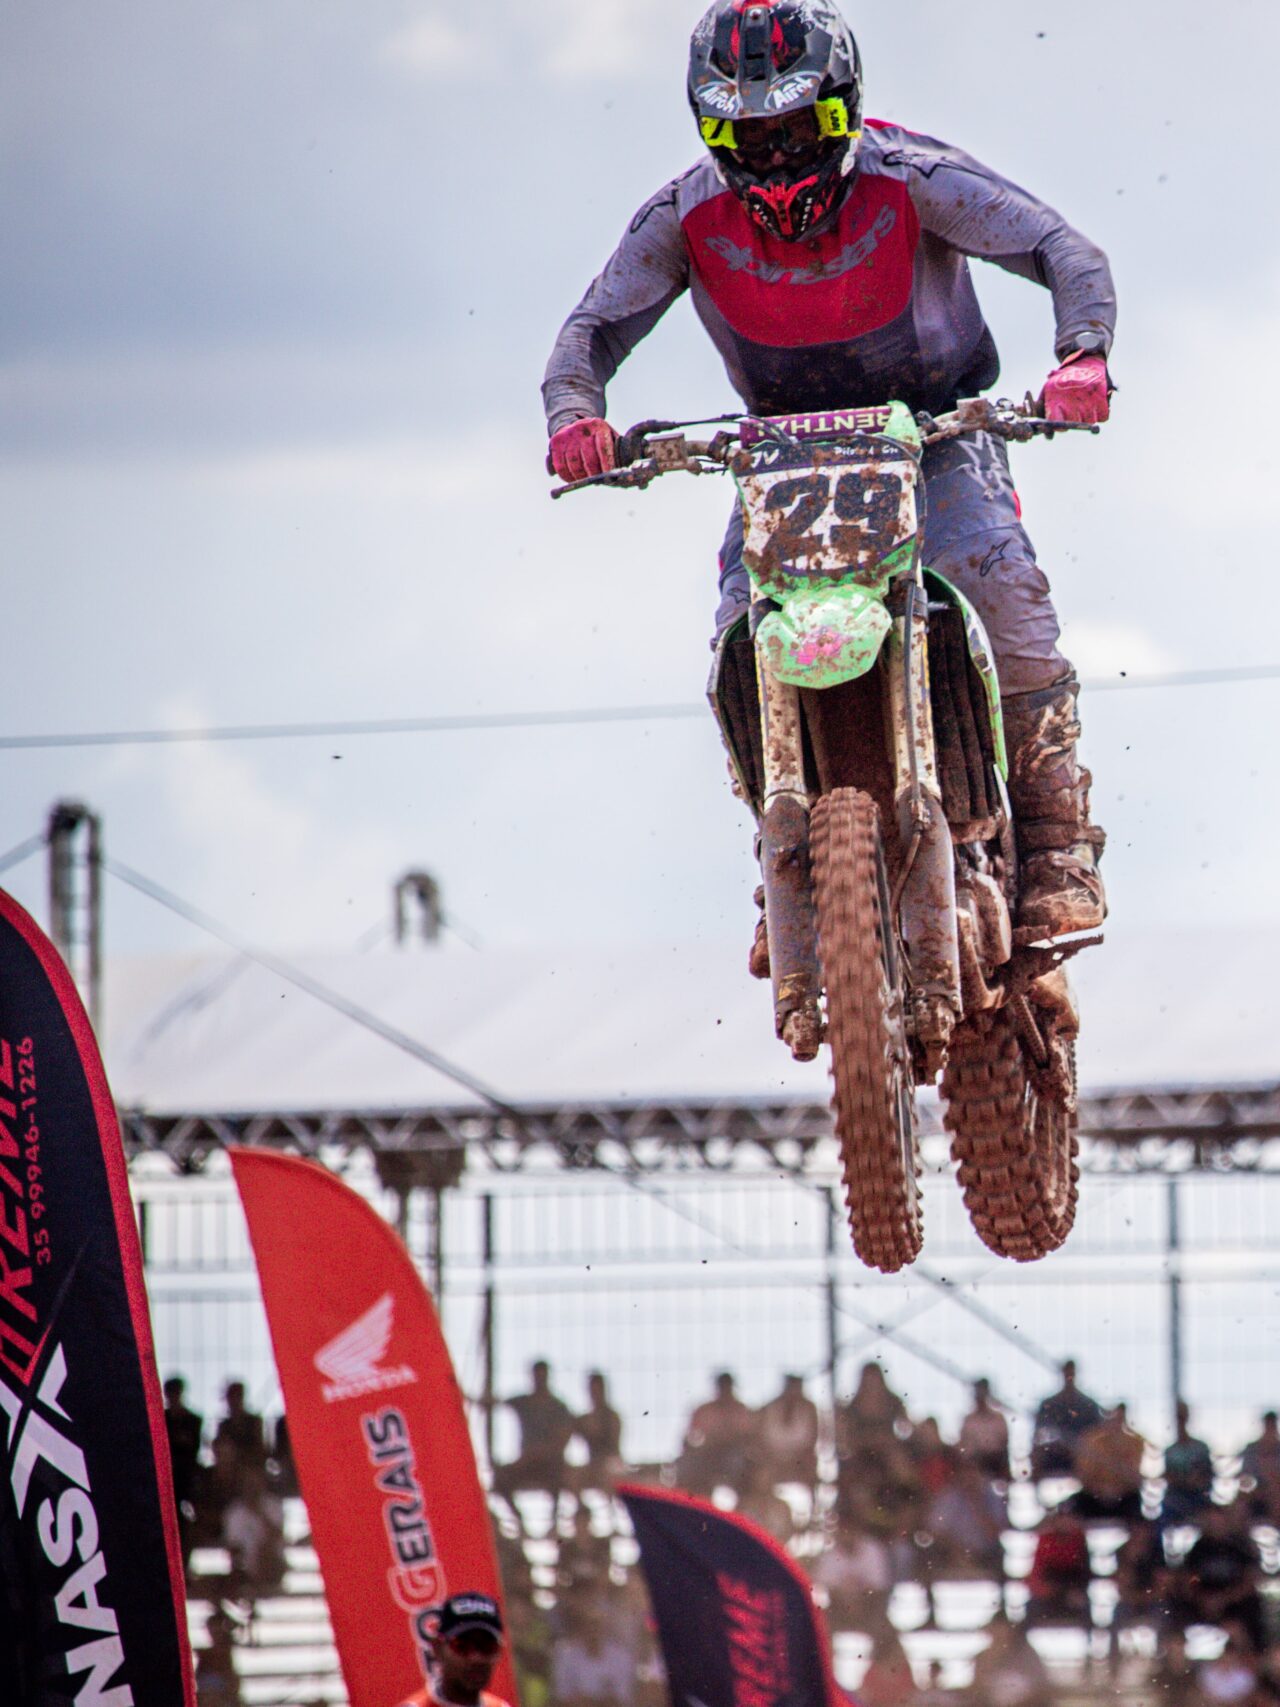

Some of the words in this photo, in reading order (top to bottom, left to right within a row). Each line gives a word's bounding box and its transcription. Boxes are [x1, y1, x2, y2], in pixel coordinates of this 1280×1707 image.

[761, 472, 902, 553] 29
[17, 1036, 47, 1220] 99946-1226
[34, 1229, 51, 1267] 35
[364, 1408, 448, 1700] TOGERAIS
